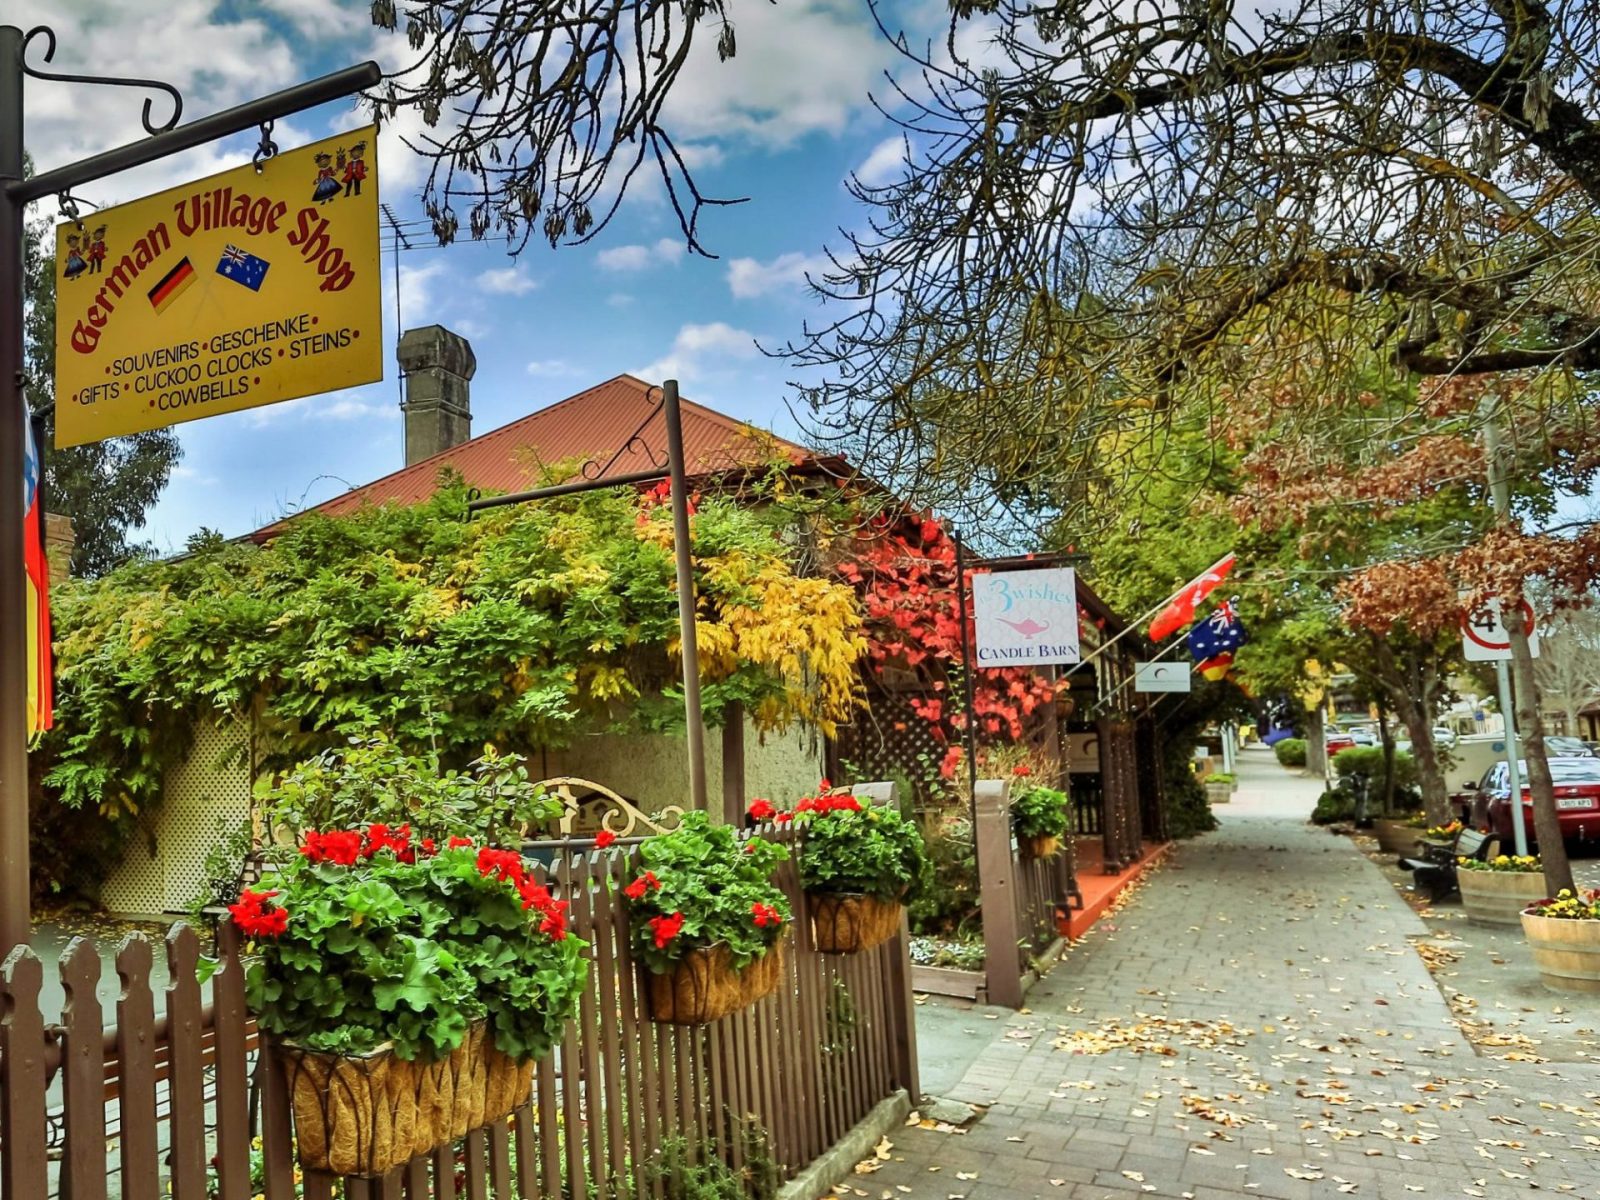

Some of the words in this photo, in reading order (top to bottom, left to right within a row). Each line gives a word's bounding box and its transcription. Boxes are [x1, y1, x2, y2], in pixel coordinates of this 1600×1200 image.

[71, 222, 171, 354] German
[174, 186, 287, 237] Village
[287, 207, 355, 293] Shop
[79, 382, 120, 405] GIFTS
[134, 364, 201, 393] CUCKOO
[206, 347, 272, 378] CLOCKS
[290, 328, 351, 359] STEINS
[112, 341, 199, 376] SOUVENIRS
[210, 314, 310, 354] GESCHENKE
[158, 376, 249, 411] COWBELLS
[978, 647, 1035, 660] CANDLE
[1039, 644, 1078, 658] BARN
